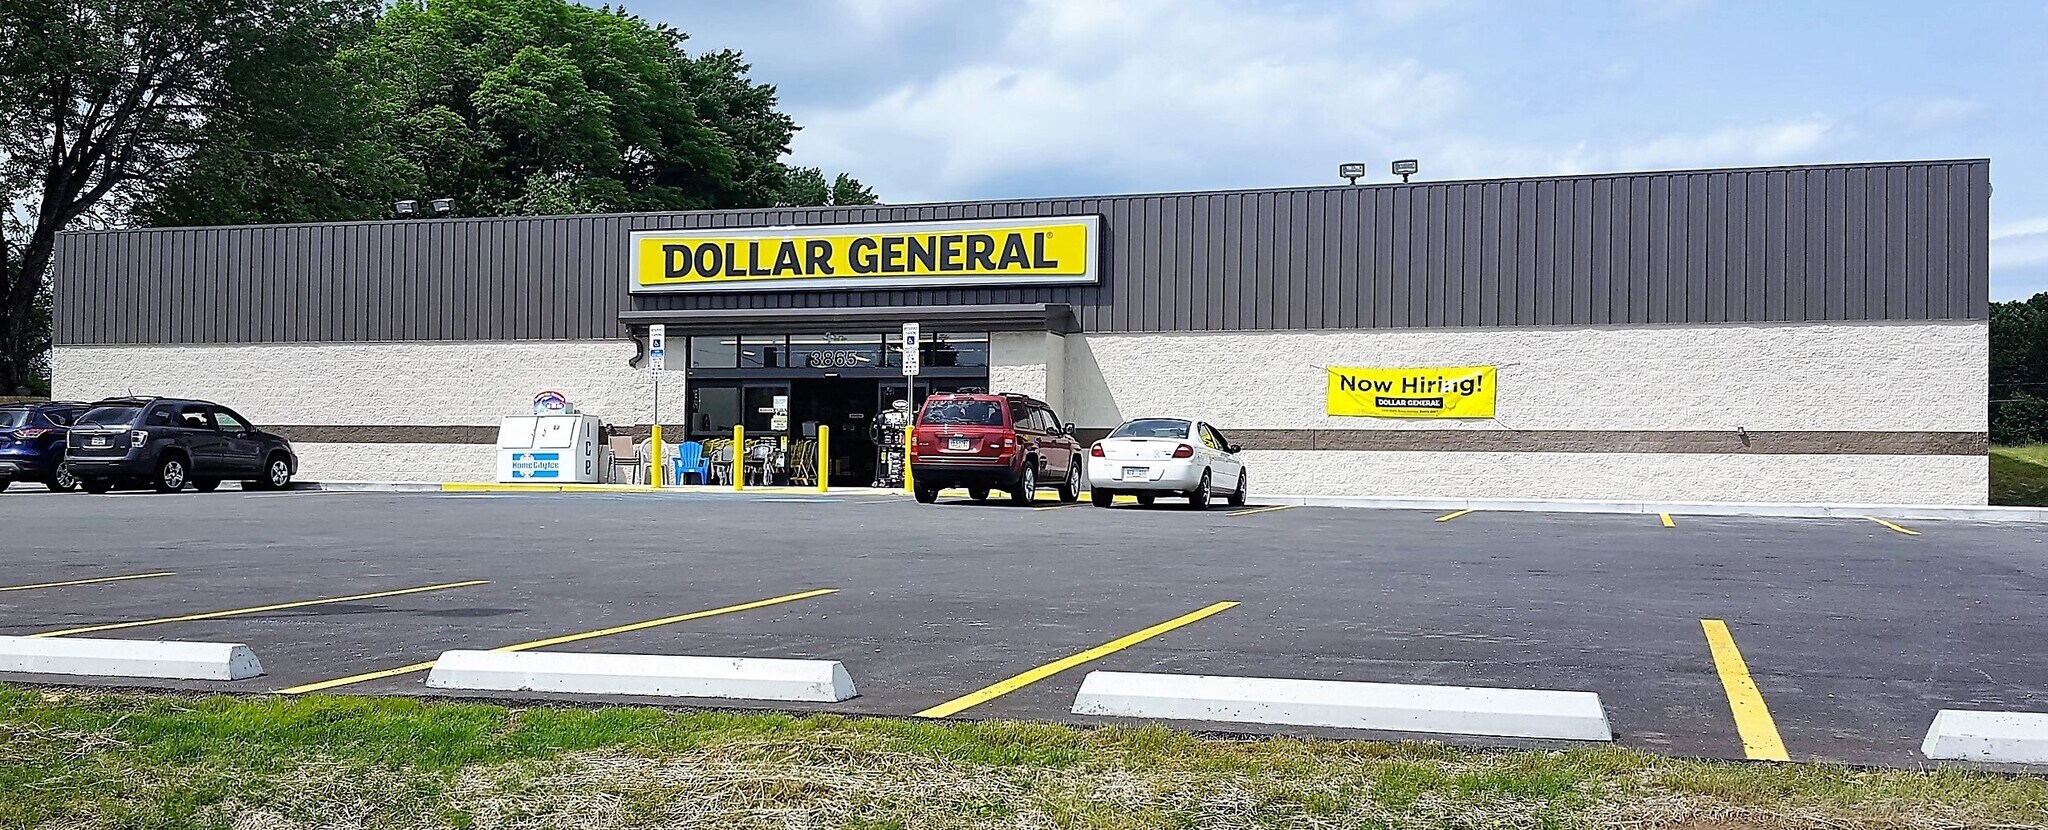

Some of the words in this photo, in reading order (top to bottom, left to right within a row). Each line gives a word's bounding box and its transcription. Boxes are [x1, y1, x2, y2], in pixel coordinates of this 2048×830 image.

[662, 239, 835, 279] DOLLAR
[848, 232, 1059, 274] GENERAL
[810, 350, 858, 367] 3865
[1340, 375, 1393, 393] Now
[1401, 375, 1483, 396] Hiring!
[1407, 399, 1441, 407] GENERAL
